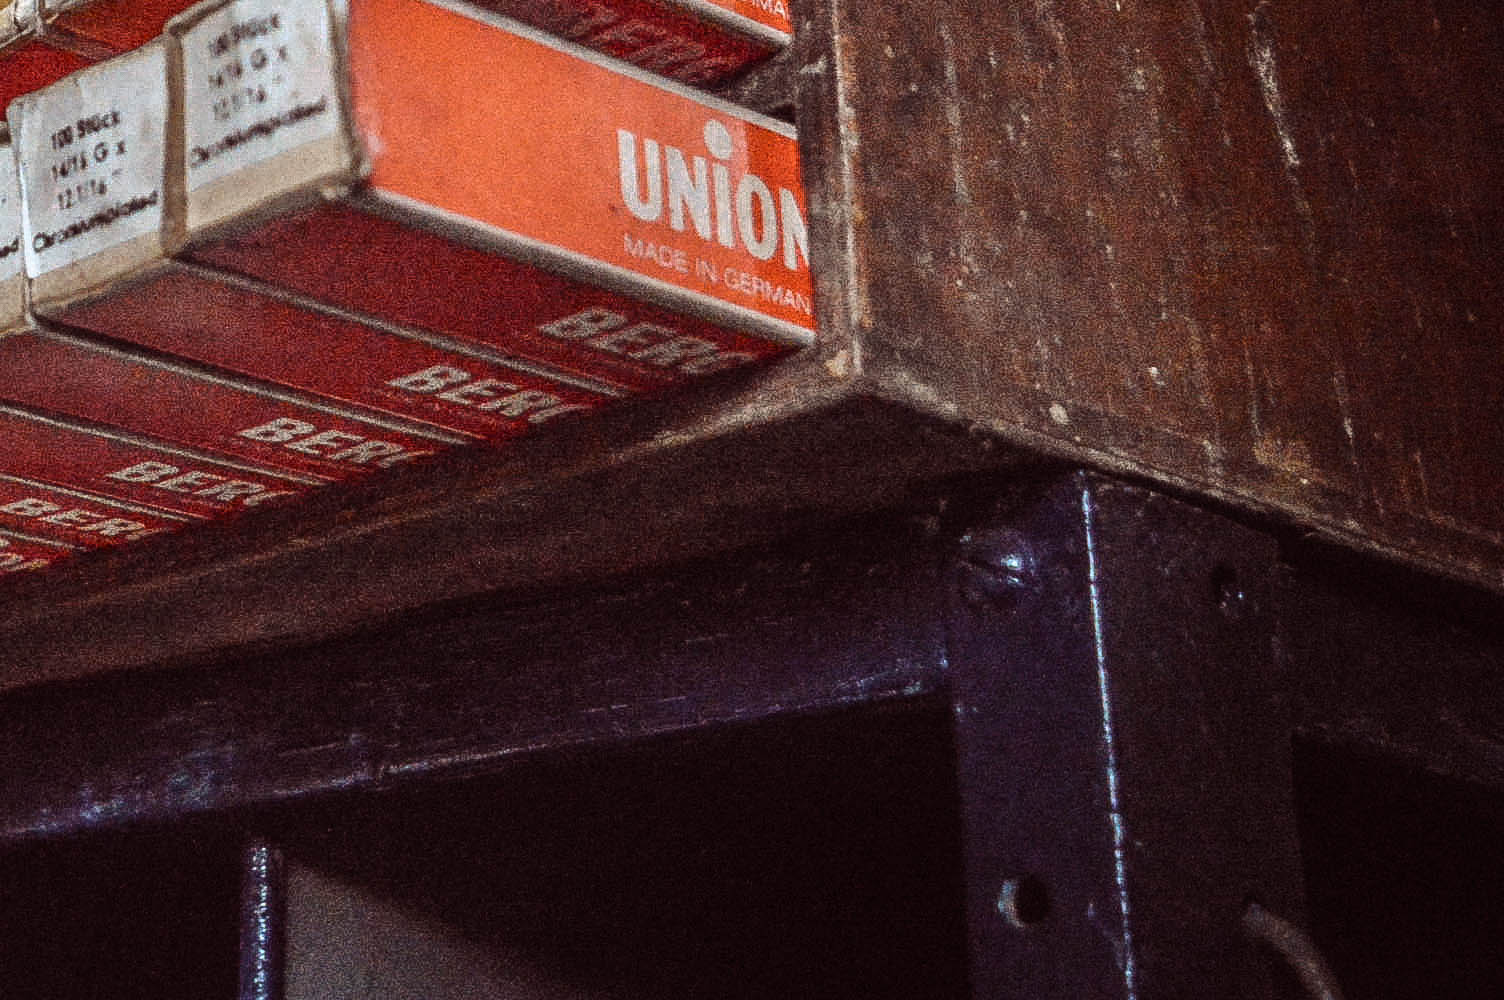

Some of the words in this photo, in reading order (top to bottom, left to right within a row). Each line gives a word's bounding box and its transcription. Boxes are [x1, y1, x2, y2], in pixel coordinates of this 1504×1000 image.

[93, 141, 109, 163] G
[623, 232, 689, 274] MADE
[695, 257, 716, 285] IN
